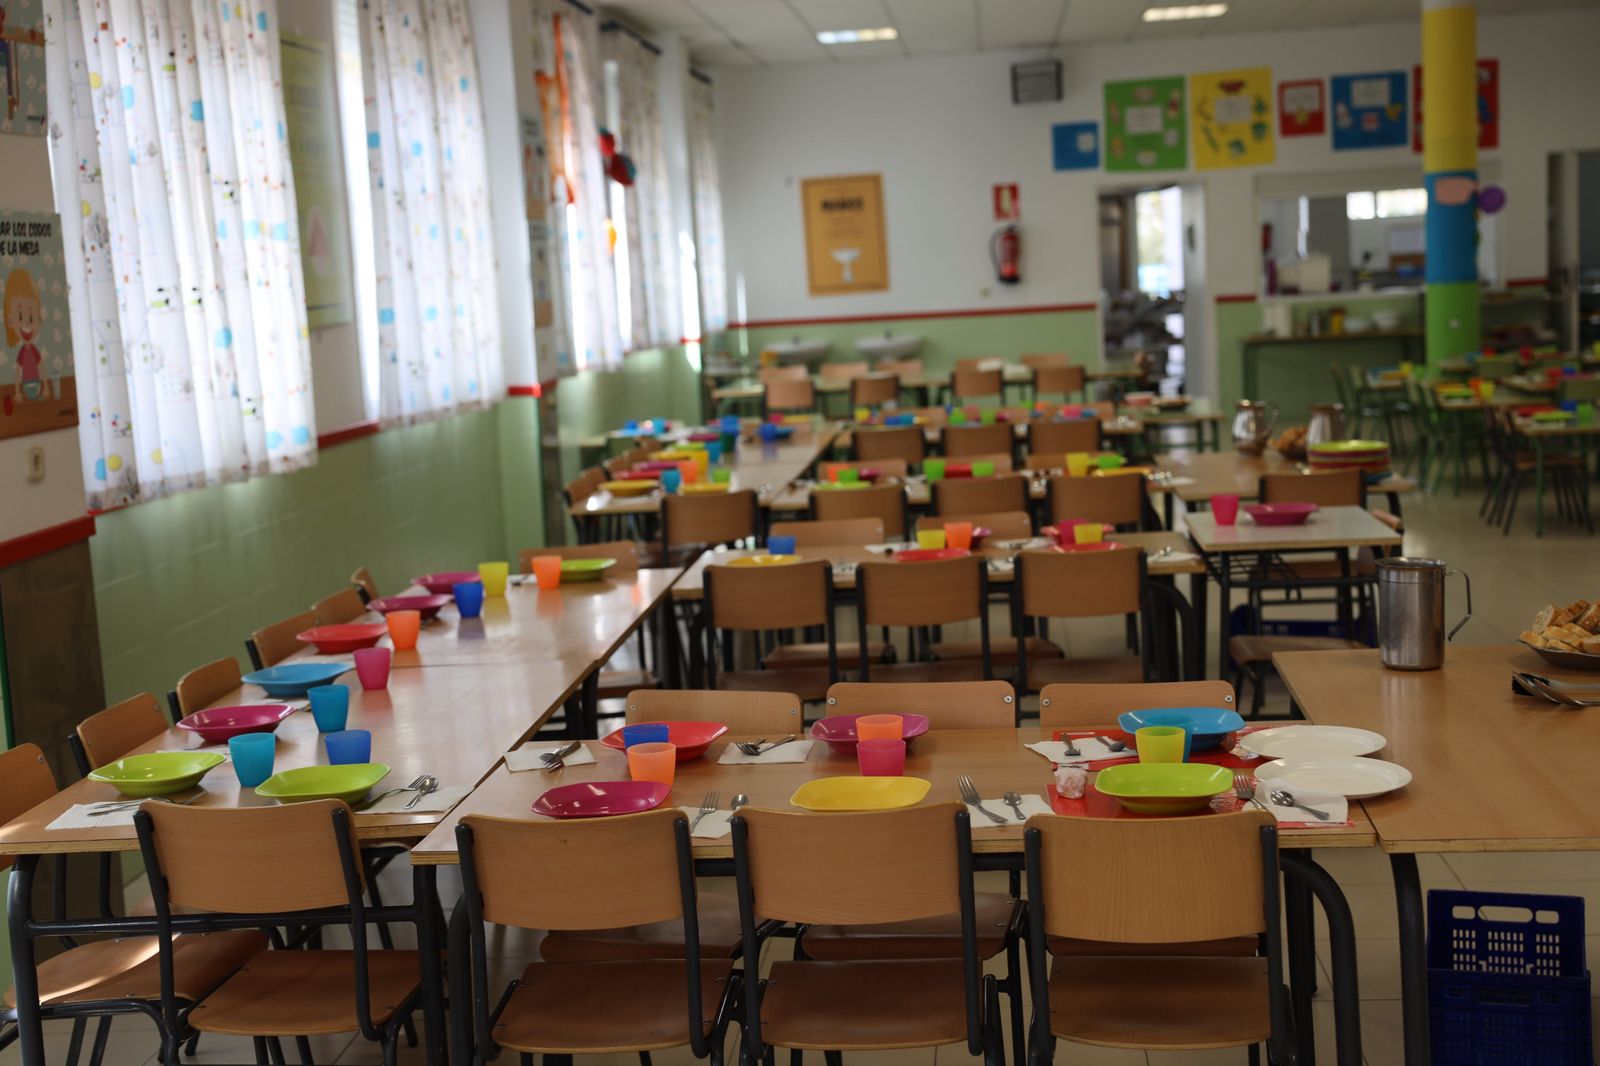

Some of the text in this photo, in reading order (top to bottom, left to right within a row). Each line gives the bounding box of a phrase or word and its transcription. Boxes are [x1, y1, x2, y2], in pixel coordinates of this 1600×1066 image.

[13, 222, 27, 237] LOS
[28, 222, 52, 237] CODOS
[7, 241, 18, 256] LA
[19, 241, 40, 256] MESA
